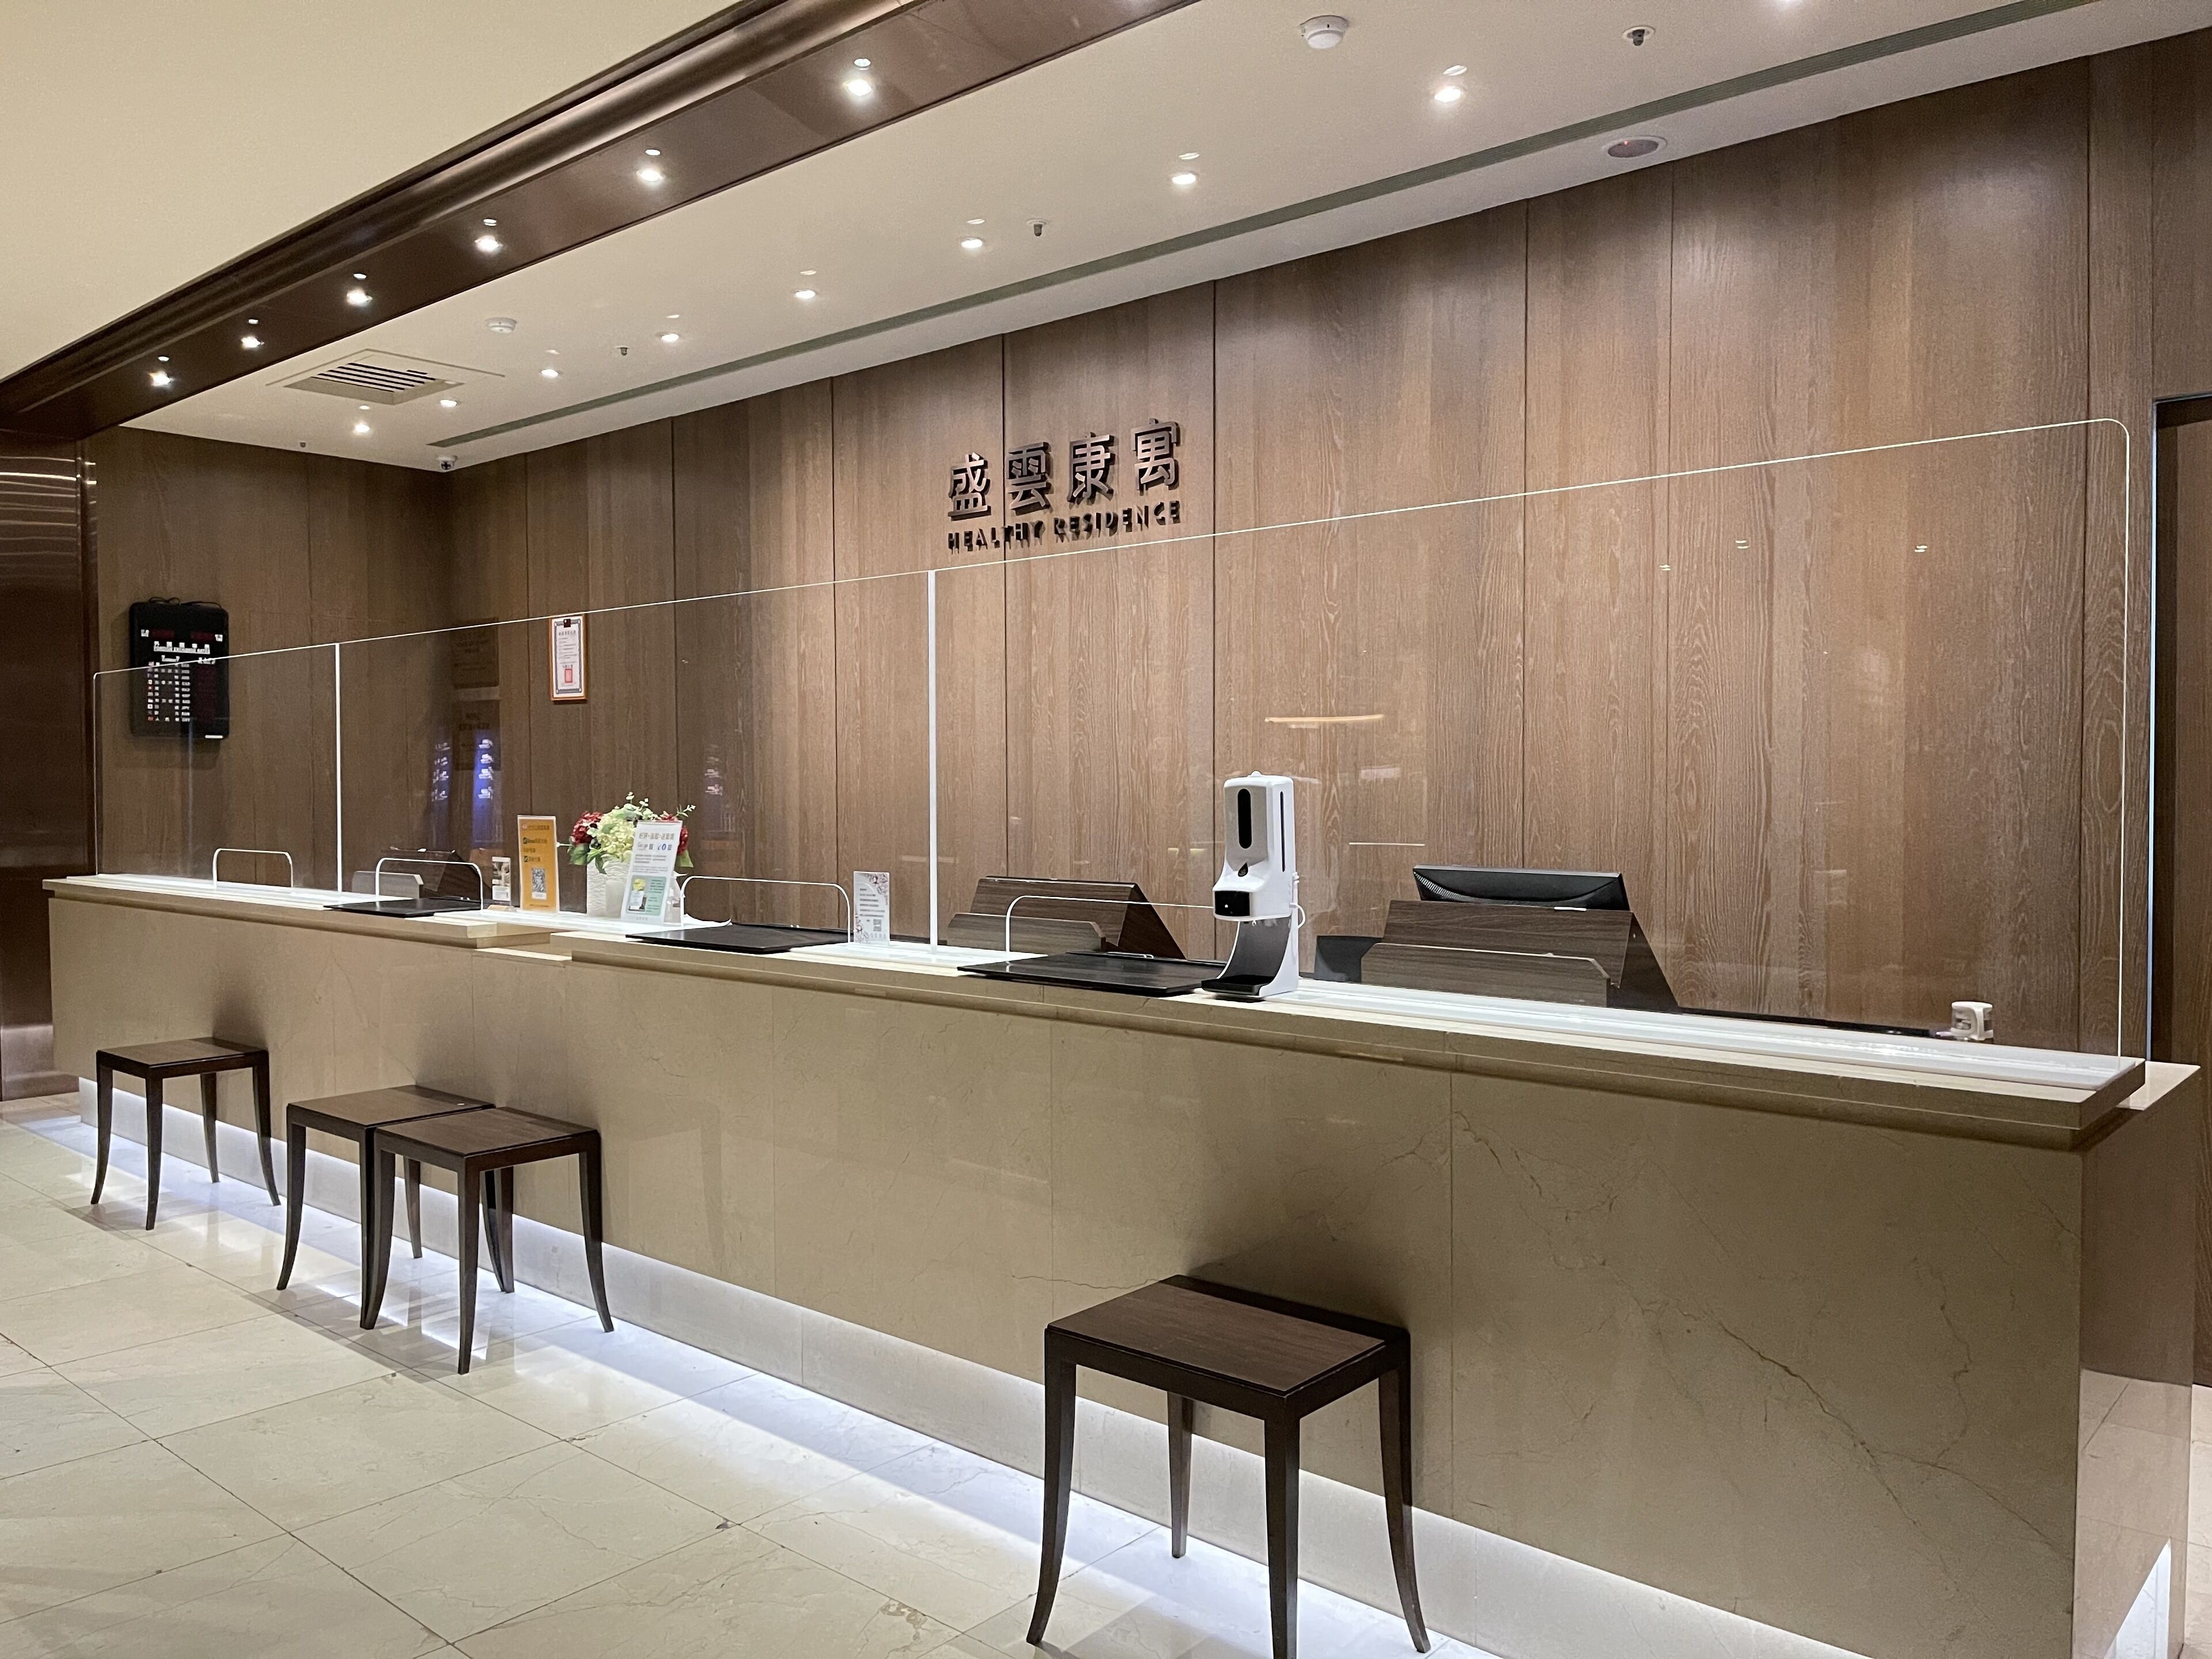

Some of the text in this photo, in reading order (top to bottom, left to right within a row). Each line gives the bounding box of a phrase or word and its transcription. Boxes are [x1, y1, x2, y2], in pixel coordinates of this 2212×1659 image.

[948, 419, 1180, 521] 盛雲康寓
[948, 500, 1181, 552] HEALTHY RESIDENCE
